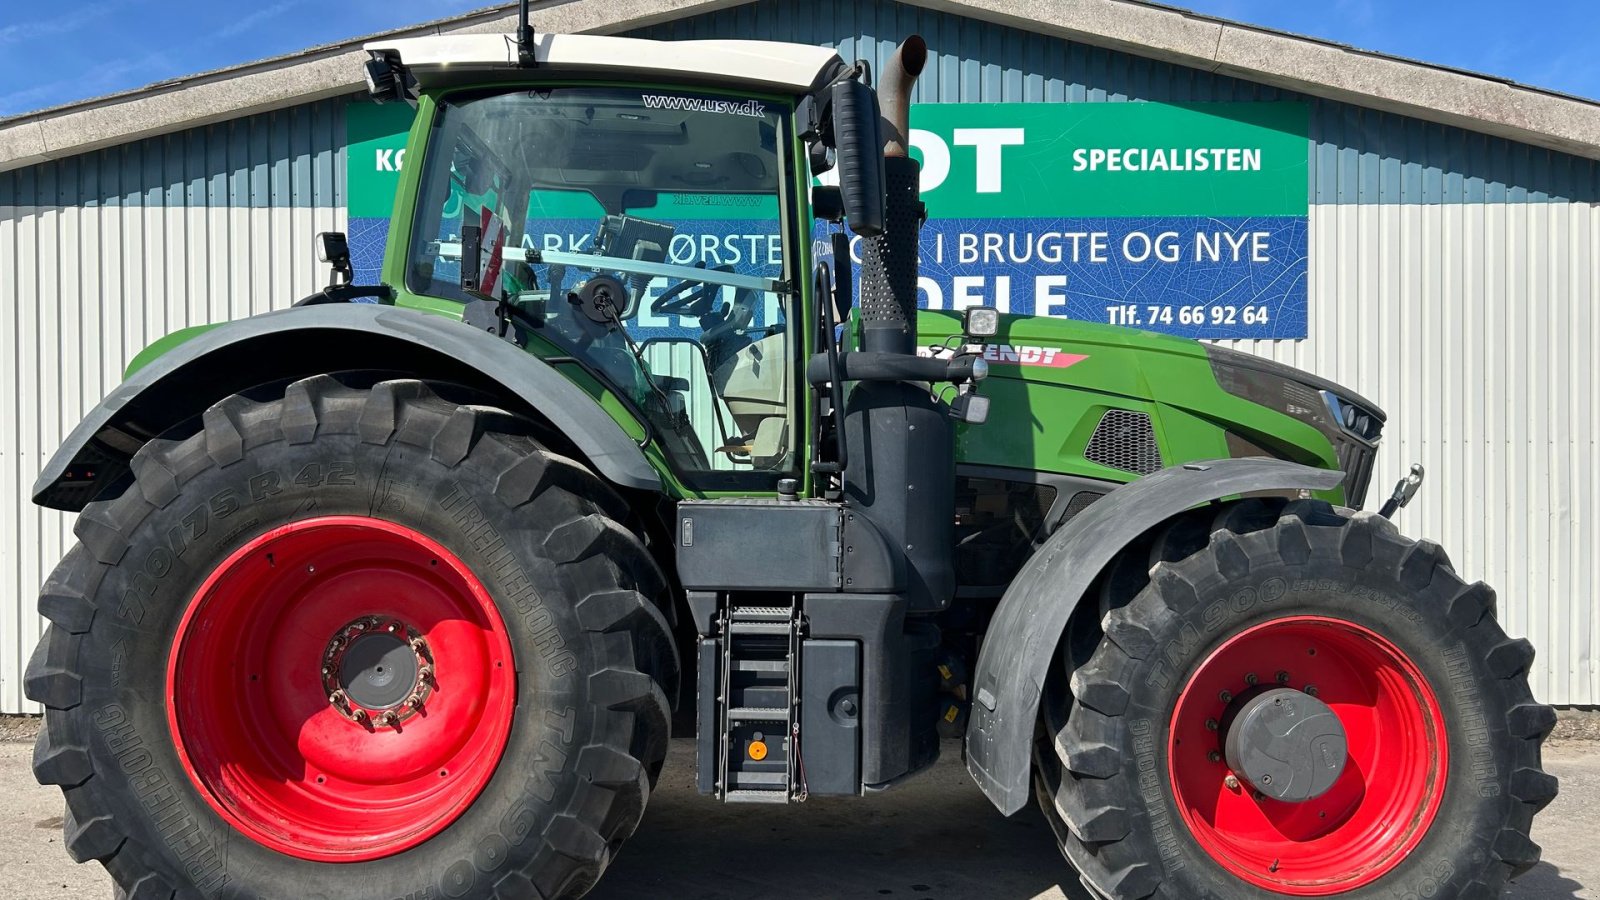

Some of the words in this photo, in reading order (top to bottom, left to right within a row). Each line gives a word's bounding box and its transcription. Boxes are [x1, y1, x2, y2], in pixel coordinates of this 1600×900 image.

[642, 95, 765, 117] www.usv.dk
[375, 149, 406, 172] KØ
[1073, 147, 1261, 172] SPECIALISTEN
[669, 234, 782, 265] ØRSTE
[937, 233, 943, 263] I
[959, 231, 1108, 263] BRUGTE
[1123, 231, 1180, 263] OG
[1196, 231, 1270, 263] NYE
[1106, 306, 1142, 325] Tlf.
[1147, 306, 1173, 325] 74
[1178, 306, 1205, 325] 66
[1210, 306, 1236, 325] 92
[1241, 306, 1268, 325] 64
[982, 344, 1062, 364] ENDT
[118, 488, 240, 625] 710/75
[249, 469, 284, 501] R
[294, 461, 357, 488] 42
[439, 480, 578, 679] TRELLEBORG
[1440, 640, 1500, 798] TRELLEBORG
[93, 703, 232, 900] TRELLEBORG
[1128, 718, 1185, 882] TRELLEBORG
